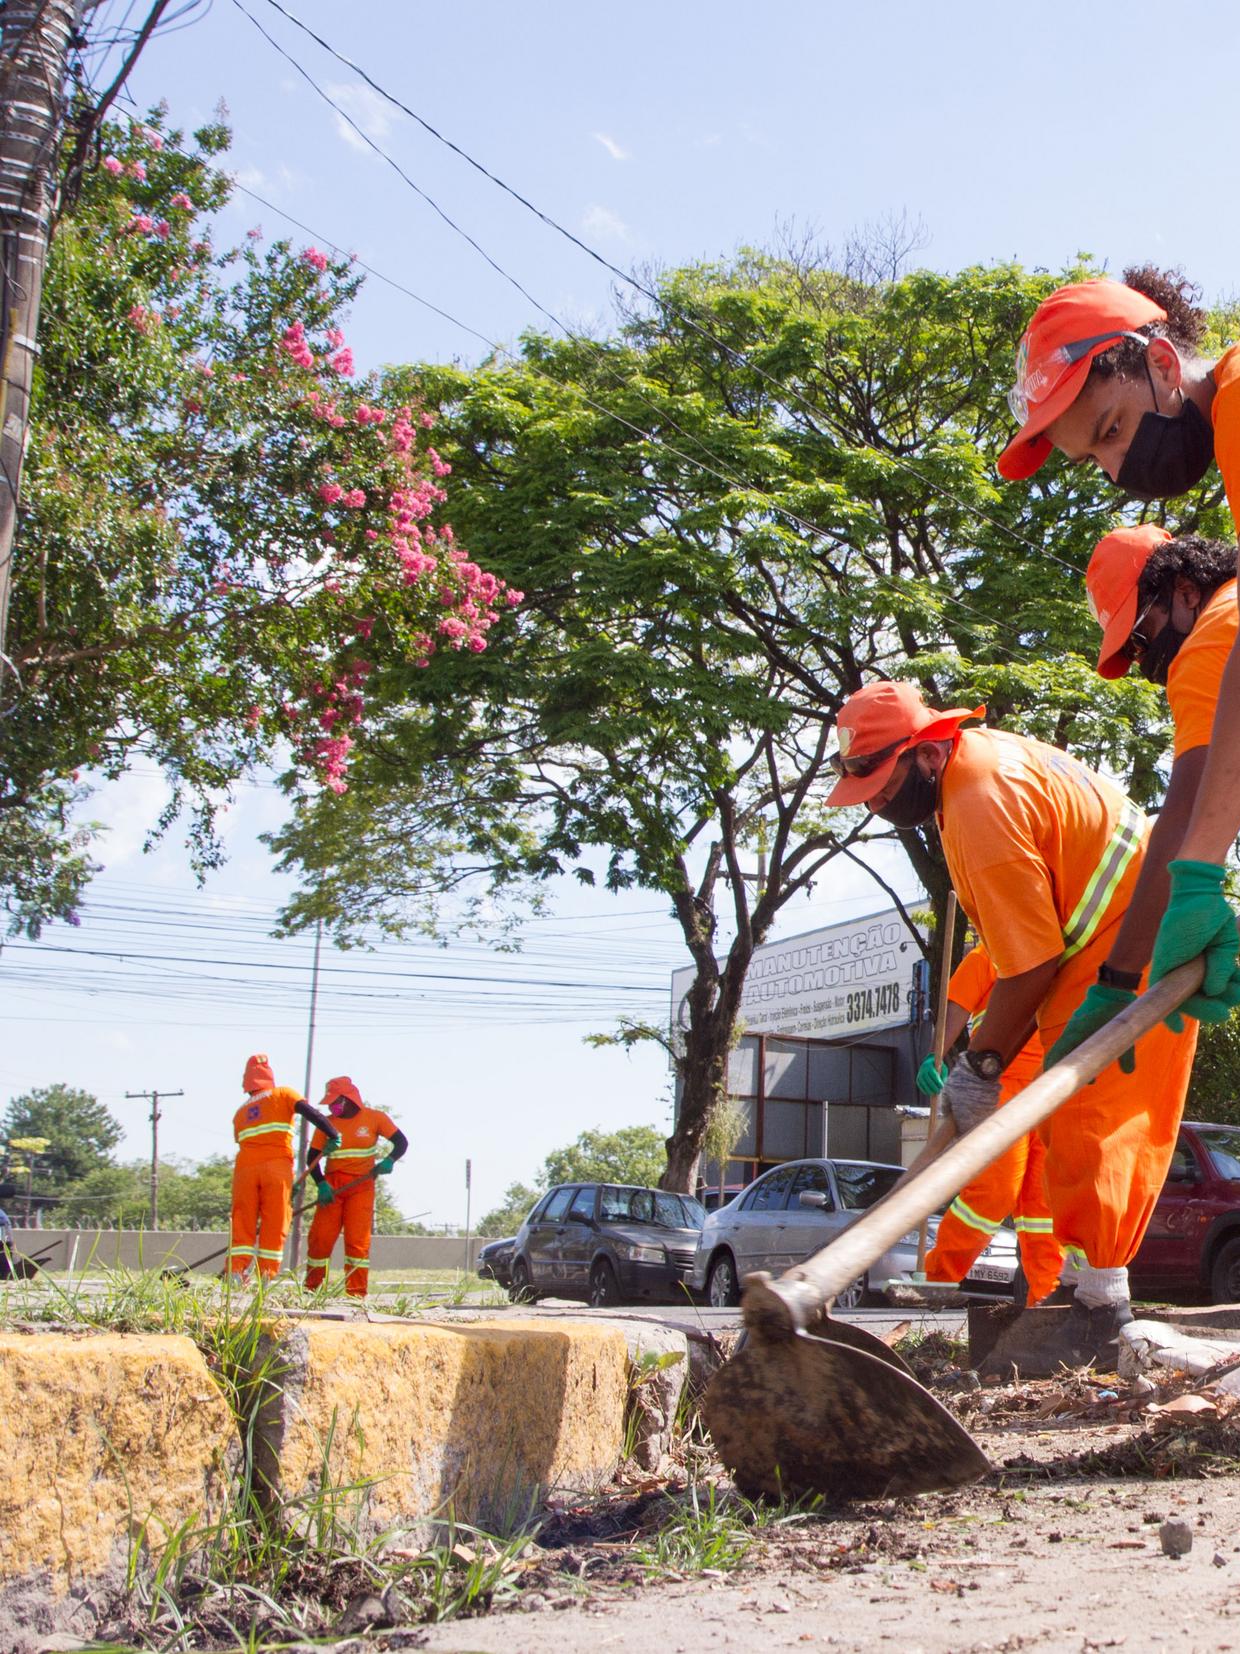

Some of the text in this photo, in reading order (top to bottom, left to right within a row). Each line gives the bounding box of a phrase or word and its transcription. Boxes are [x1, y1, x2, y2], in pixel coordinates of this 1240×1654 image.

[745, 951, 897, 1006] AUTOMOTIVA
[746, 922, 900, 981] MANUTENÇÃO
[847, 982, 899, 1023] 3374.7478
